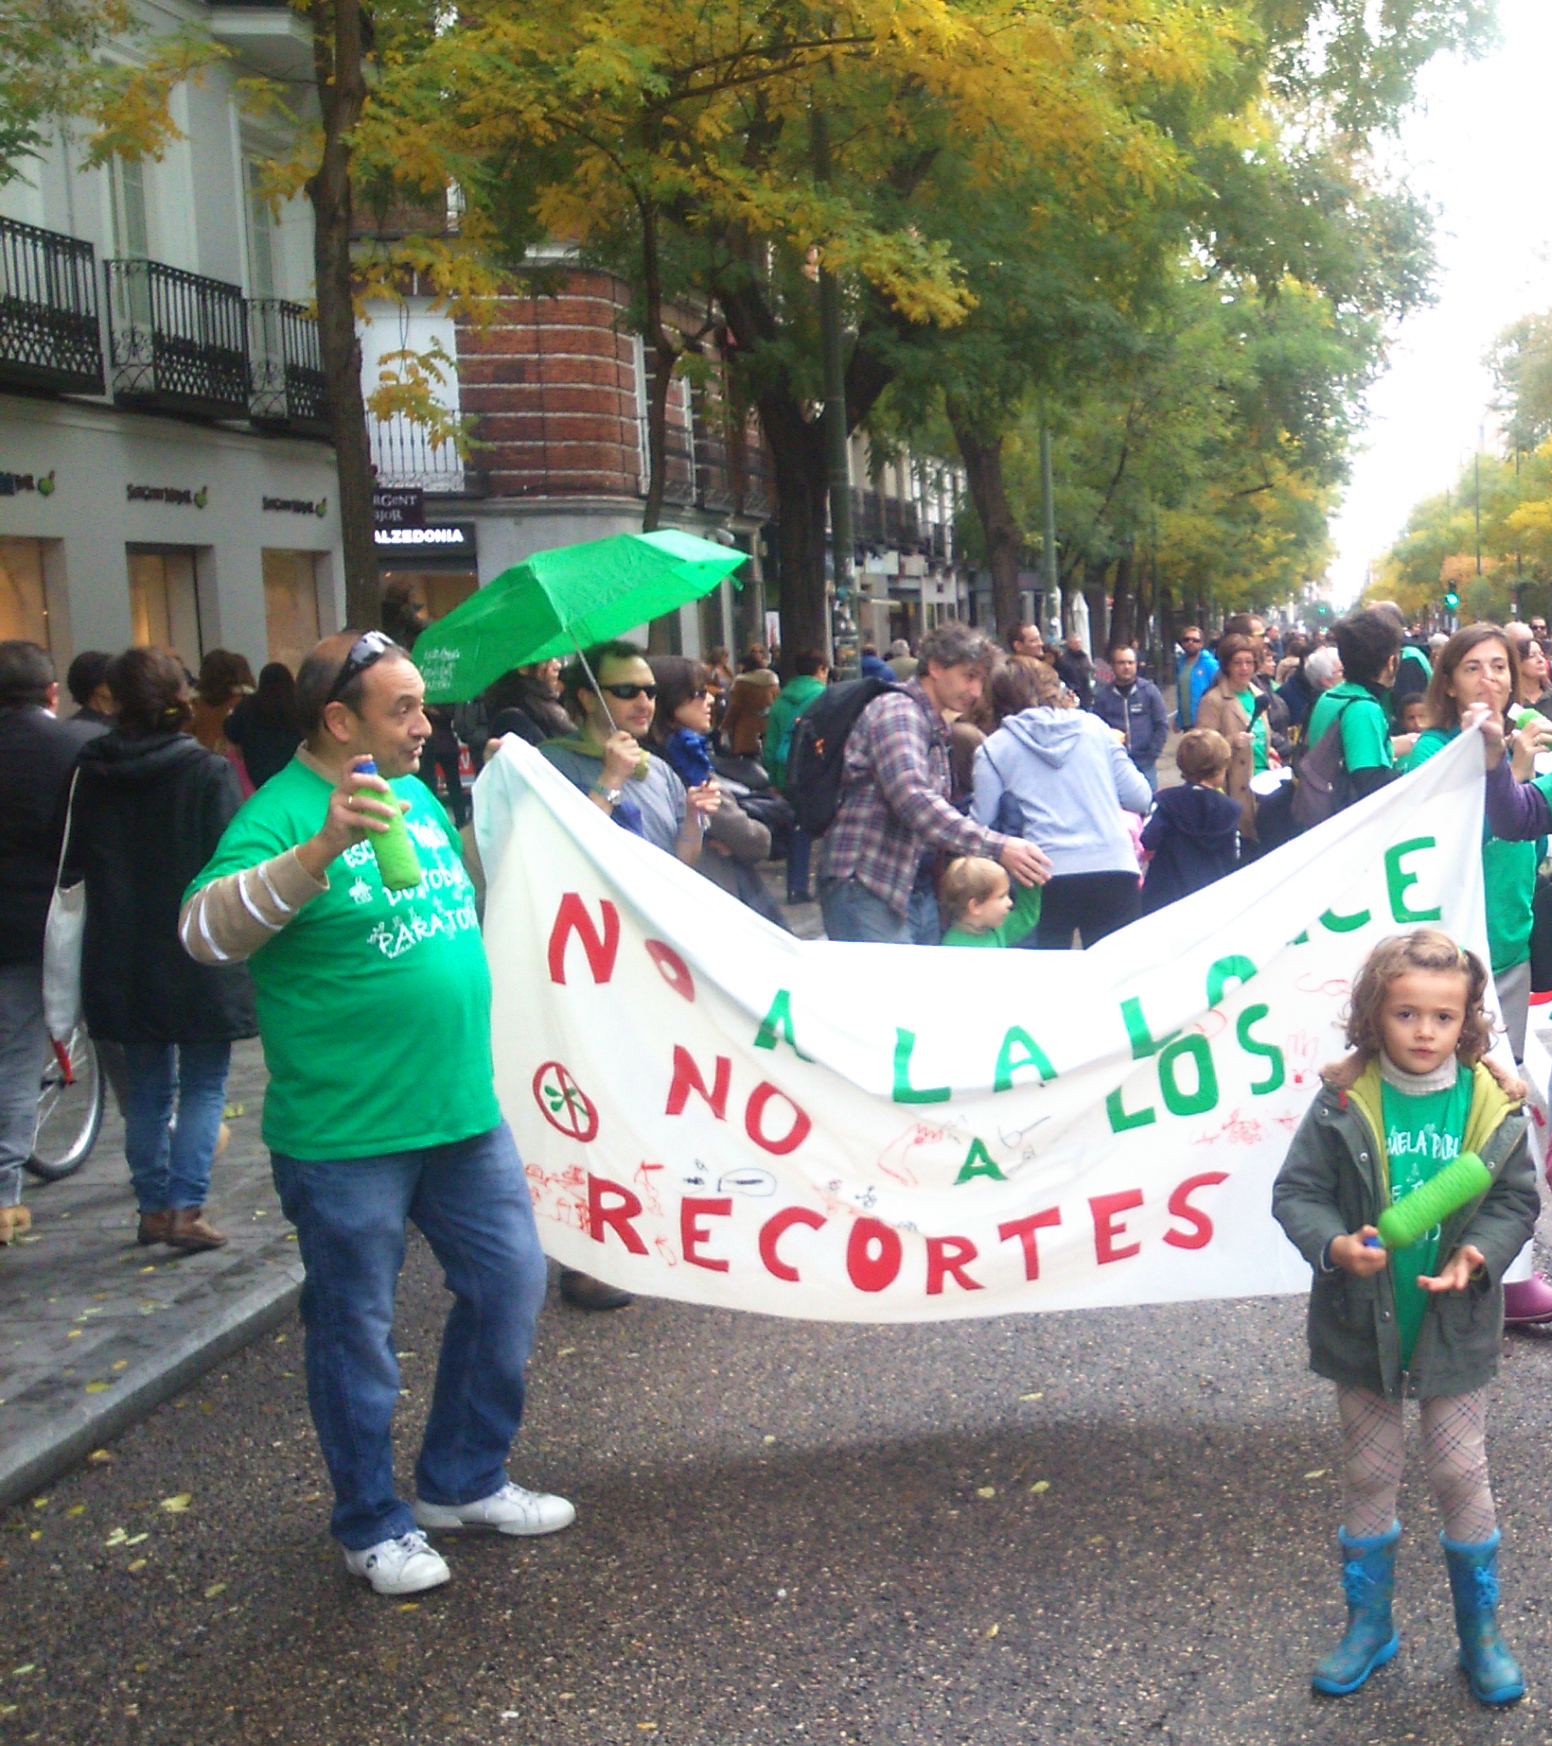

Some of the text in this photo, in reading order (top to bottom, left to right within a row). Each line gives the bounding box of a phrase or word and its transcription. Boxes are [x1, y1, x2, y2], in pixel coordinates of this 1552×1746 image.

[374, 528, 464, 544] ALZEDONIA
[547, 891, 696, 1003] NO
[753, 988, 816, 1064] A
[892, 1025, 1058, 1105] LA
[664, 1002, 1286, 1186] NO A LOS
[587, 1170, 1231, 1296] RECORTES
